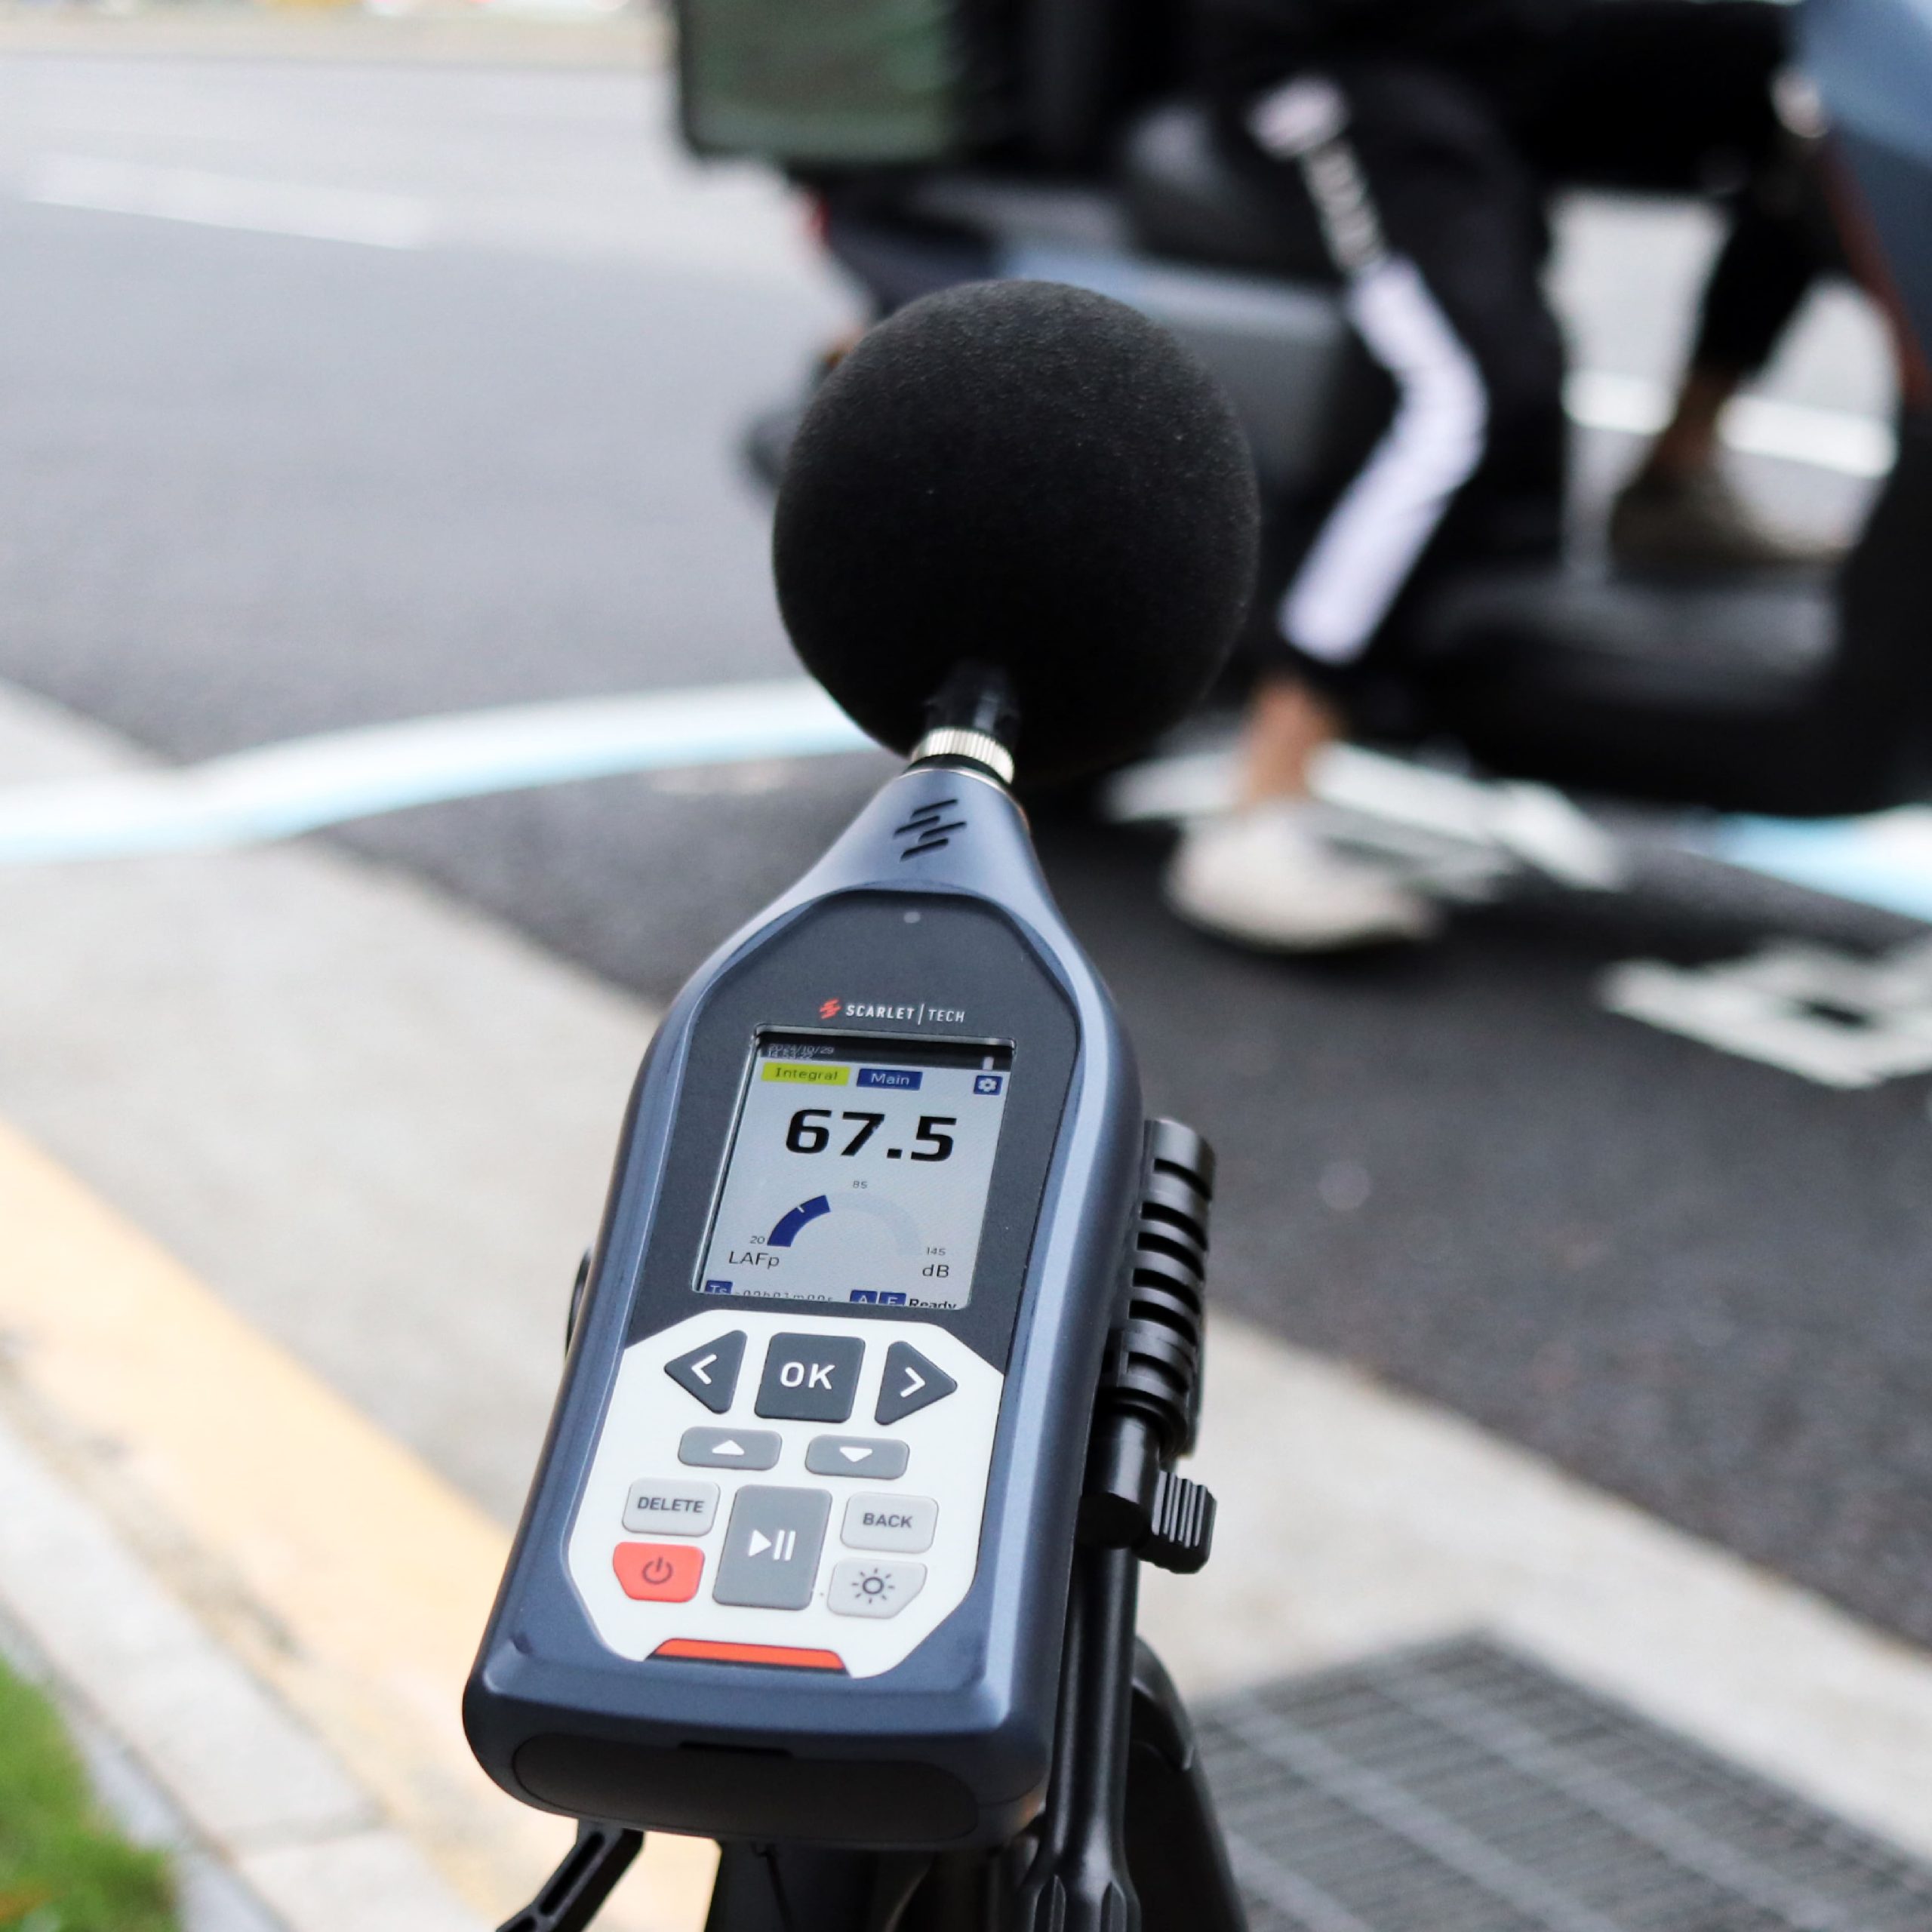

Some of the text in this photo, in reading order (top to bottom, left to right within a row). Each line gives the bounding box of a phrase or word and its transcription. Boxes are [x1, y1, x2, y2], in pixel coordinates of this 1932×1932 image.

[845, 1004, 965, 1023] SCARLET TECH
[776, 1067, 838, 1081] Integral
[871, 1072, 910, 1086] Main
[786, 1109, 957, 1162] 67.5
[750, 1235, 765, 1245] 20
[728, 1251, 780, 1269] LAFp
[925, 1246, 946, 1257] 145
[922, 1264, 949, 1278] dB
[780, 1361, 835, 1389] OK
[637, 1497, 705, 1514] DELETE
[863, 1512, 912, 1529] BACK
